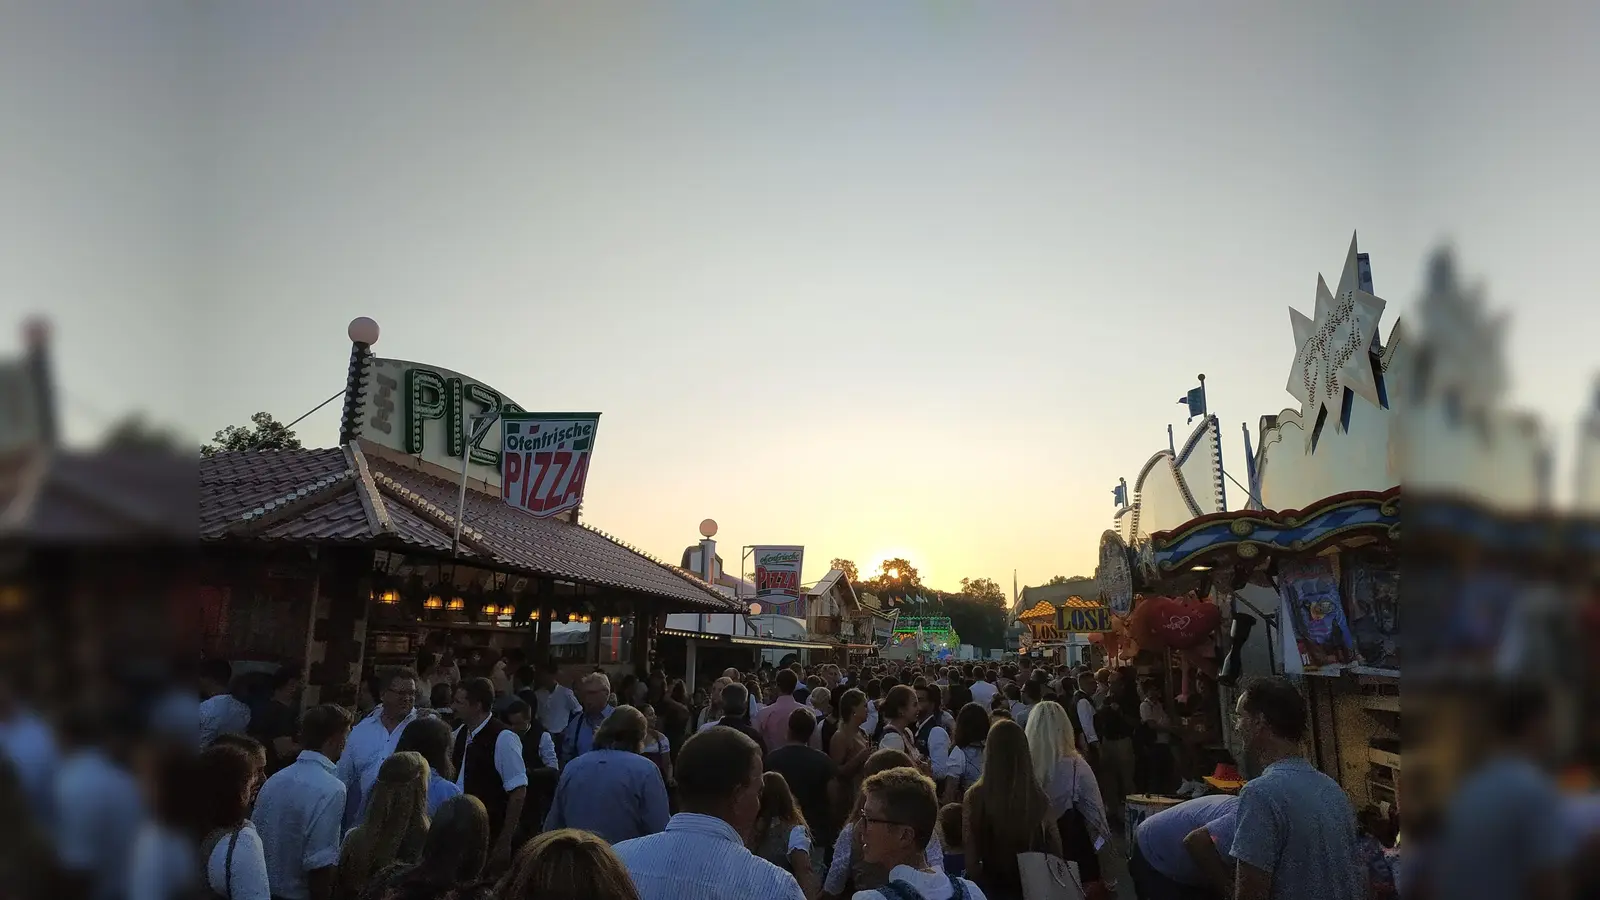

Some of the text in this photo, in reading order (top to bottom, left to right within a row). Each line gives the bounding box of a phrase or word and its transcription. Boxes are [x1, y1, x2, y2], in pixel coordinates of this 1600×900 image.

[405, 369, 527, 465] PIZ
[507, 422, 592, 451] Ofenfrische
[503, 451, 588, 512] PIZZA
[757, 566, 798, 590] PIZZA
[1056, 608, 1112, 631] LOSE
